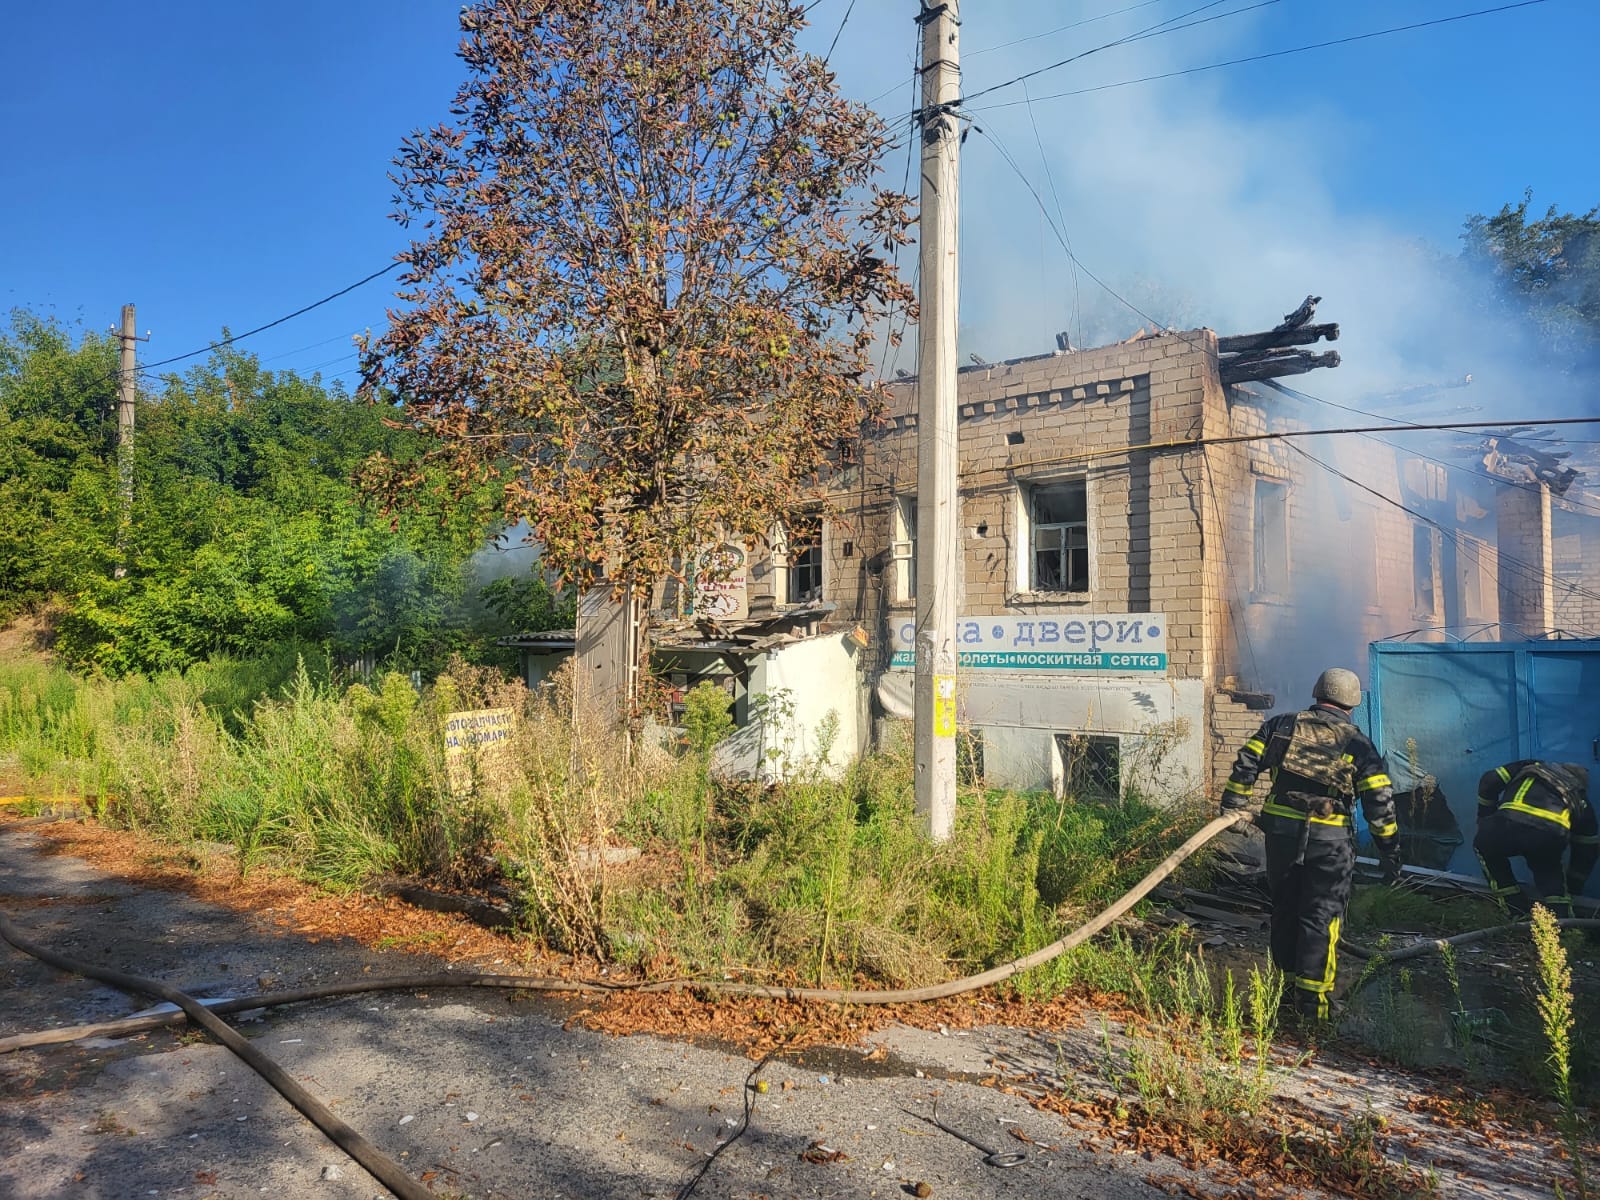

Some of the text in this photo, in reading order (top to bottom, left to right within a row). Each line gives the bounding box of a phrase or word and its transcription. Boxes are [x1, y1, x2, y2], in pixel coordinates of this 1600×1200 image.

[900, 619, 1144, 653] оа двери
[894, 652, 917, 662] жал
[1016, 654, 1102, 666] москитная
[1110, 655, 1160, 667] сетка
[445, 735, 460, 748] НА
